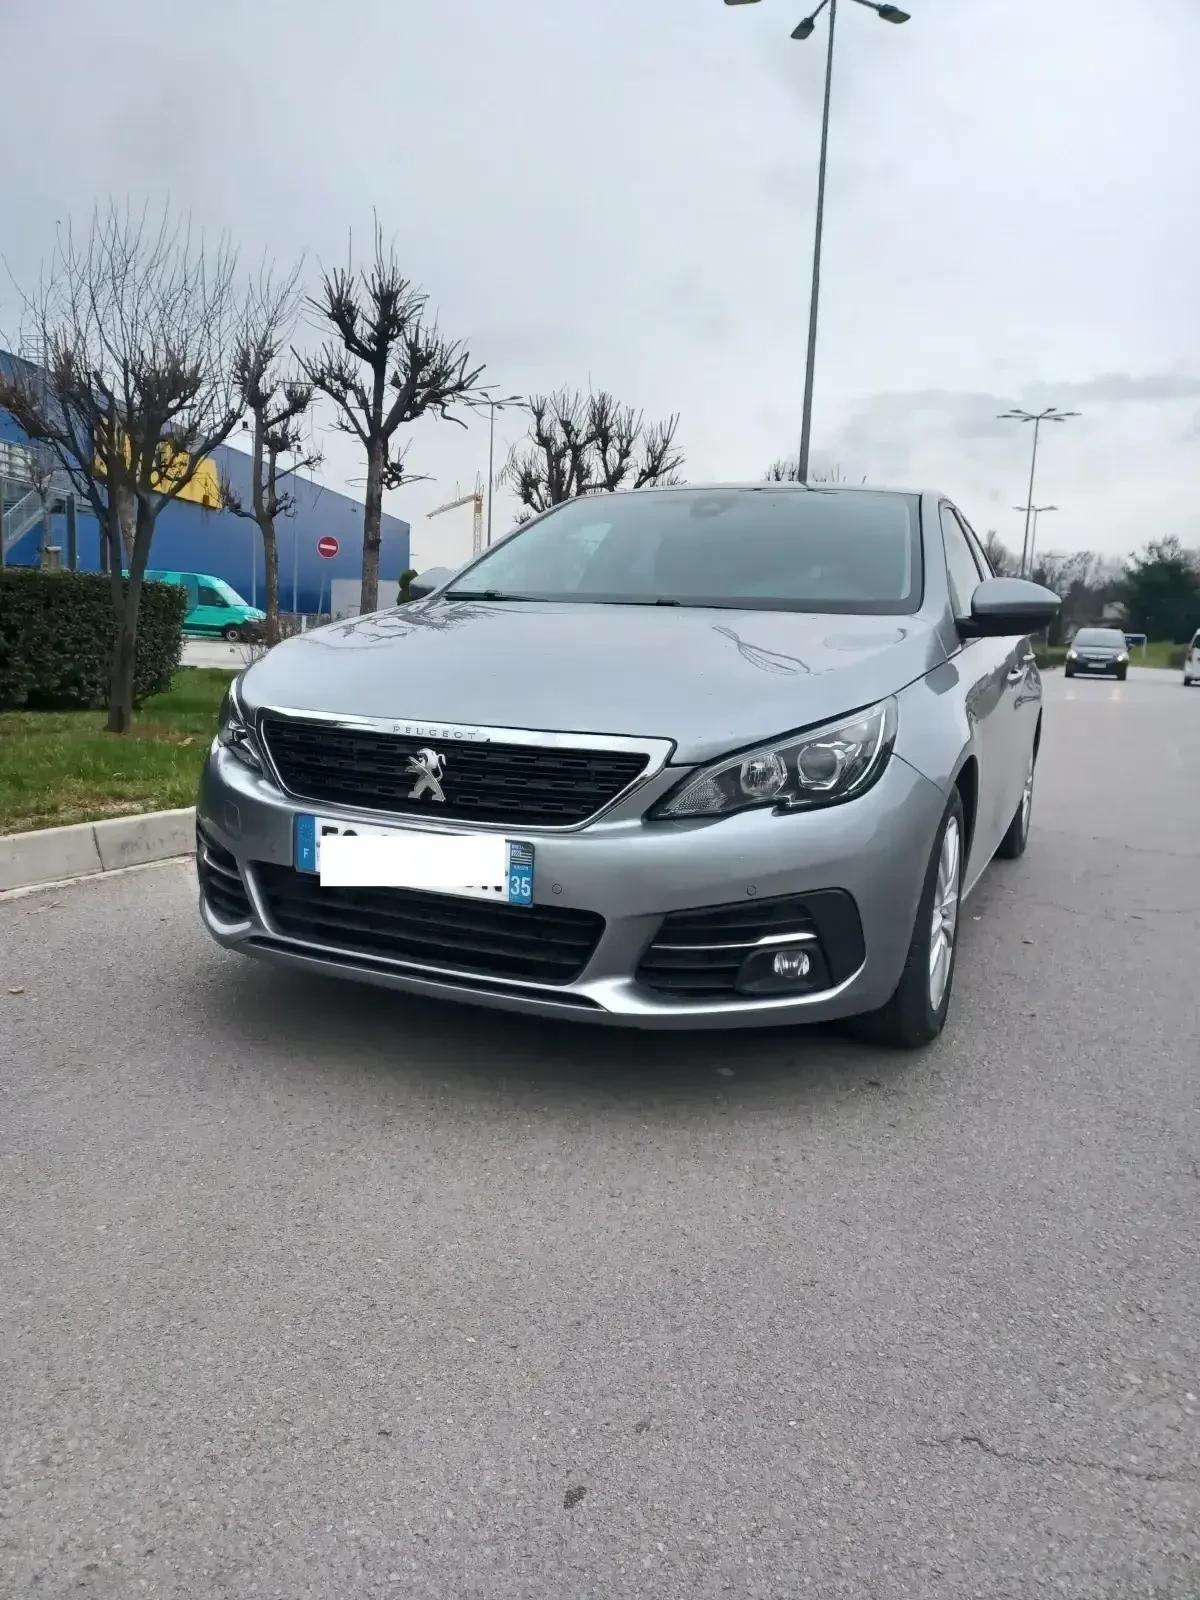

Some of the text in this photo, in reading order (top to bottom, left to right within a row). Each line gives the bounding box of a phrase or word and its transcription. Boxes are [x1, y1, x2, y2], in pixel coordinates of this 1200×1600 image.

[392, 725, 476, 740] PEUGEOT
[303, 847, 310, 859] F
[510, 875, 531, 897] 35
